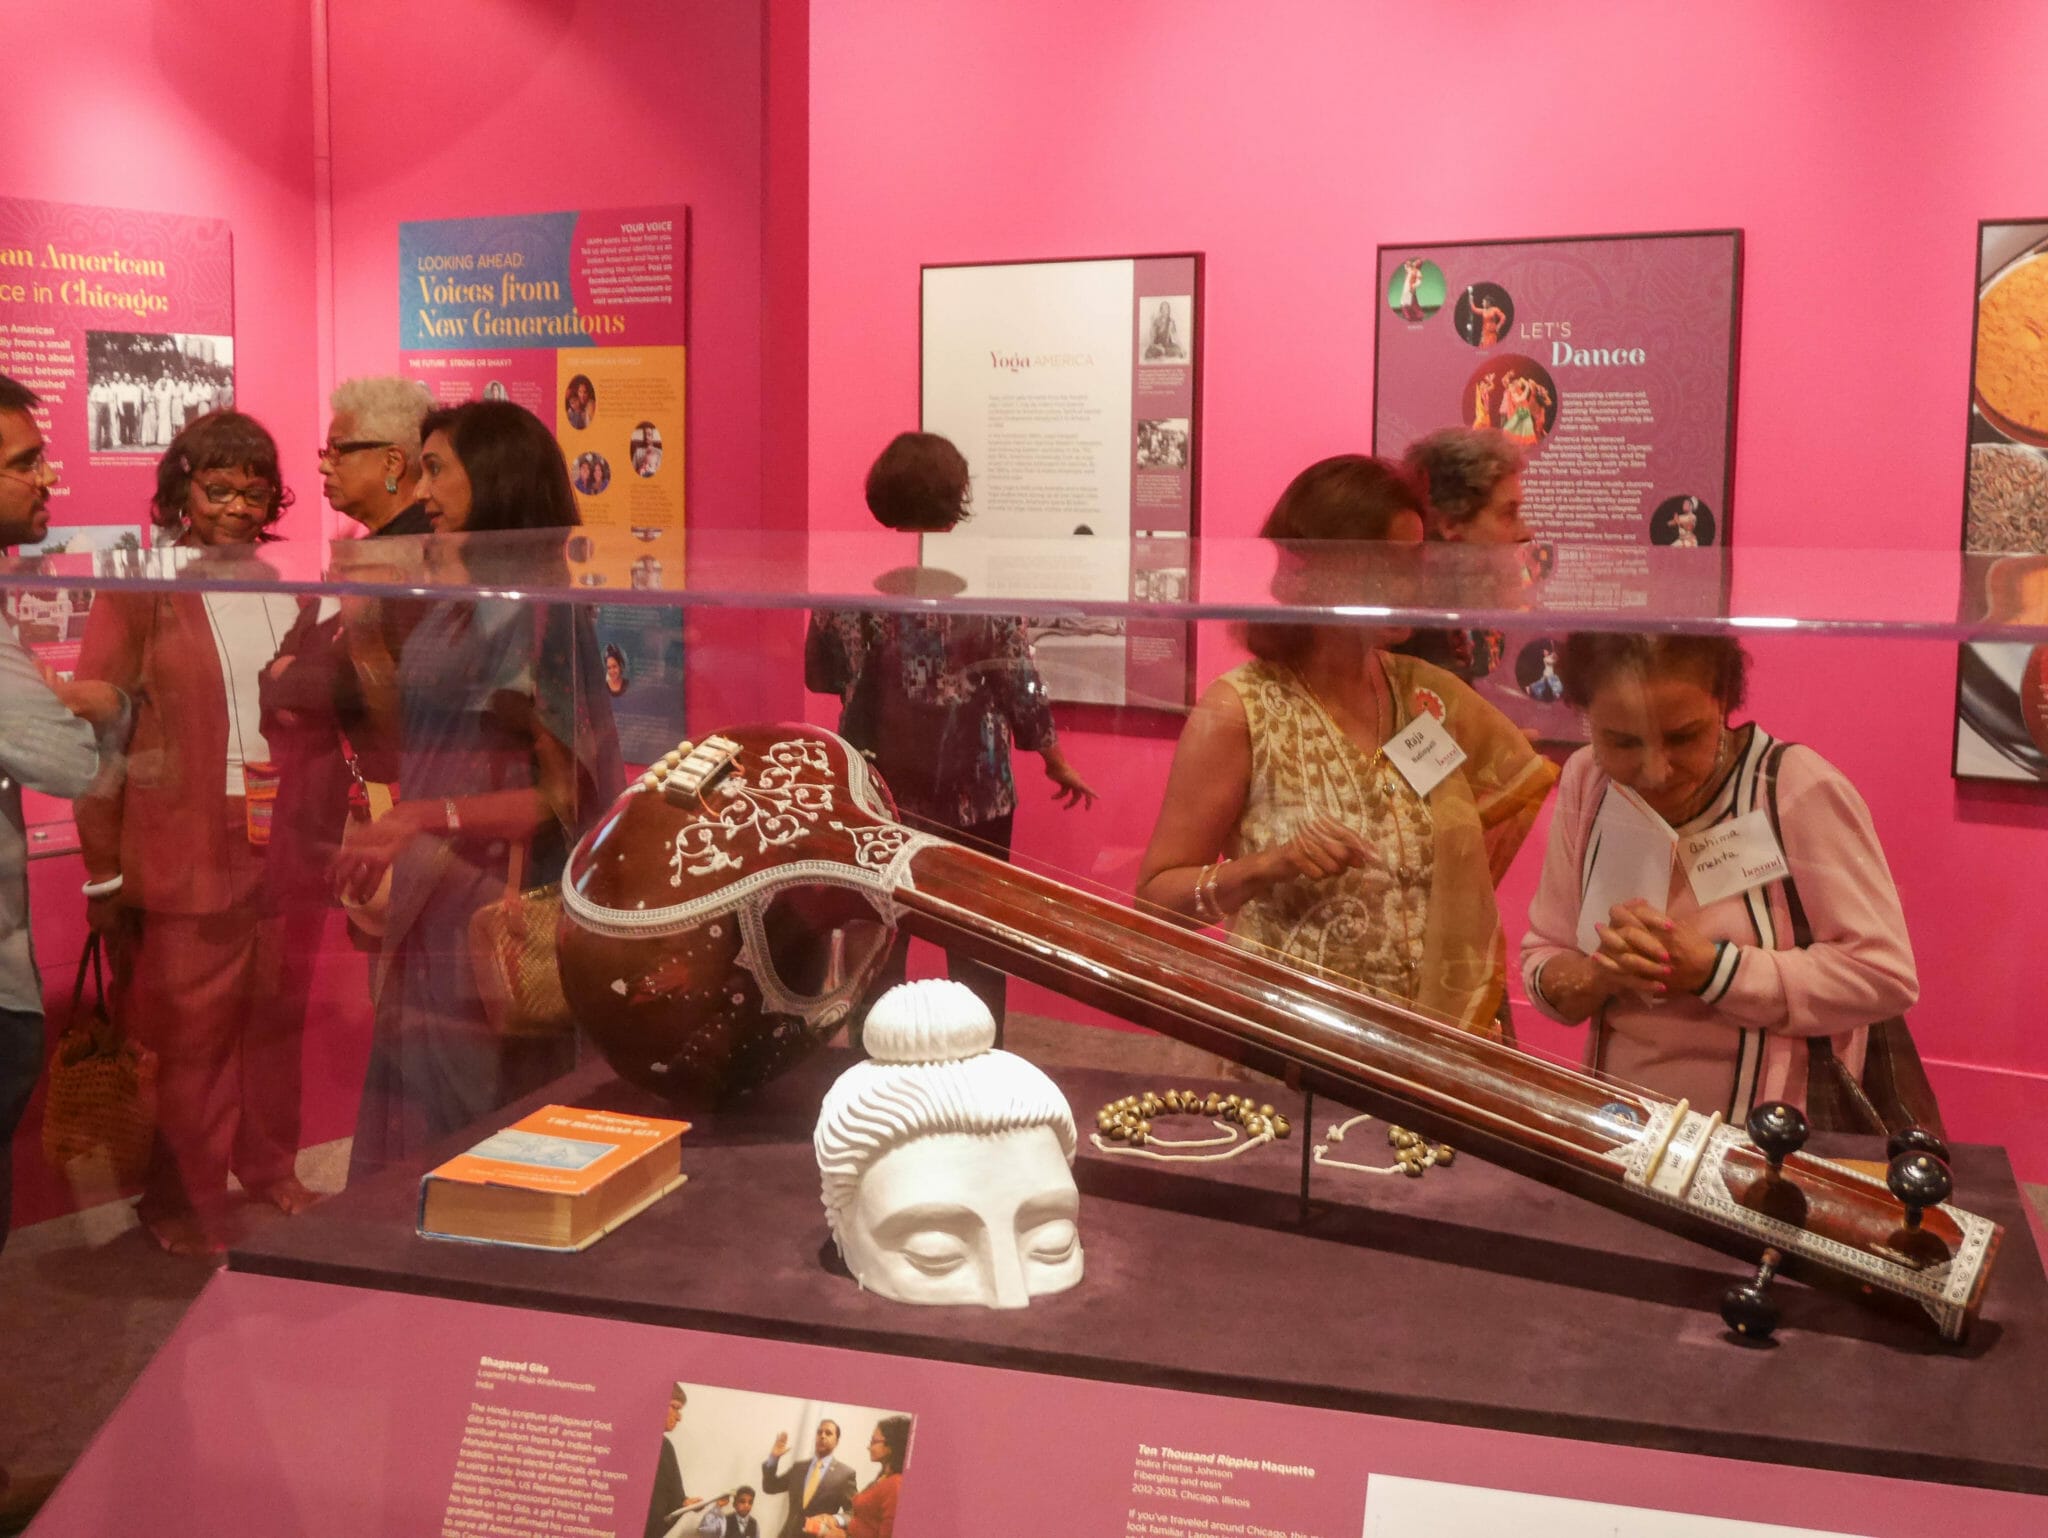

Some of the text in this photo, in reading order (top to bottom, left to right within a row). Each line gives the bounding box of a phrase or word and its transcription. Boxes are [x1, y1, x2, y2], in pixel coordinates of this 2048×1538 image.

[621, 221, 672, 233] YOUR VOICE
[41, 244, 165, 277] American
[418, 253, 525, 272] LOOKING AHEAD:
[33, 282, 52, 303] in
[61, 279, 168, 317] Chicago:
[419, 272, 560, 307] Voices from
[11, 324, 55, 335] American
[419, 306, 626, 337] New Generations
[1520, 321, 1571, 340] LET'S
[14, 338, 37, 348] from
[46, 340, 70, 349] small
[35, 353, 46, 361] to
[48, 353, 74, 363] about
[449, 358, 475, 367] STRONG
[476, 359, 486, 367] OR
[991, 351, 1095, 372] Yoga AMERICA
[1551, 341, 1646, 367] Dance
[35, 366, 74, 377] between
[1404, 731, 1424, 750] Raja
[480, 1356, 549, 1374] Bhagavad Gita
[477, 1369, 507, 1381] Loaned
[507, 1373, 518, 1383] by
[471, 1402, 485, 1413] The
[486, 1405, 511, 1417] Hindu
[549, 1425, 559, 1435] of
[561, 1428, 592, 1440] ancient
[557, 1450, 597, 1465] American
[1139, 1444, 1315, 1478] Ten Thousand Ripples Maquette
[1135, 1458, 1233, 1480] Indira Freitas Johnson
[1134, 1470, 1222, 1491] Fiberglass and resin
[1132, 1483, 1251, 1509] 2012-2013, Chicago, Illinois
[583, 1503, 614, 1516] placed
[1126, 1521, 1147, 1533] look
[1128, 1508, 1136, 1518] If
[1137, 1511, 1168, 1522] you've
[1170, 1515, 1209, 1529] traveled
[1210, 1520, 1244, 1534] around
